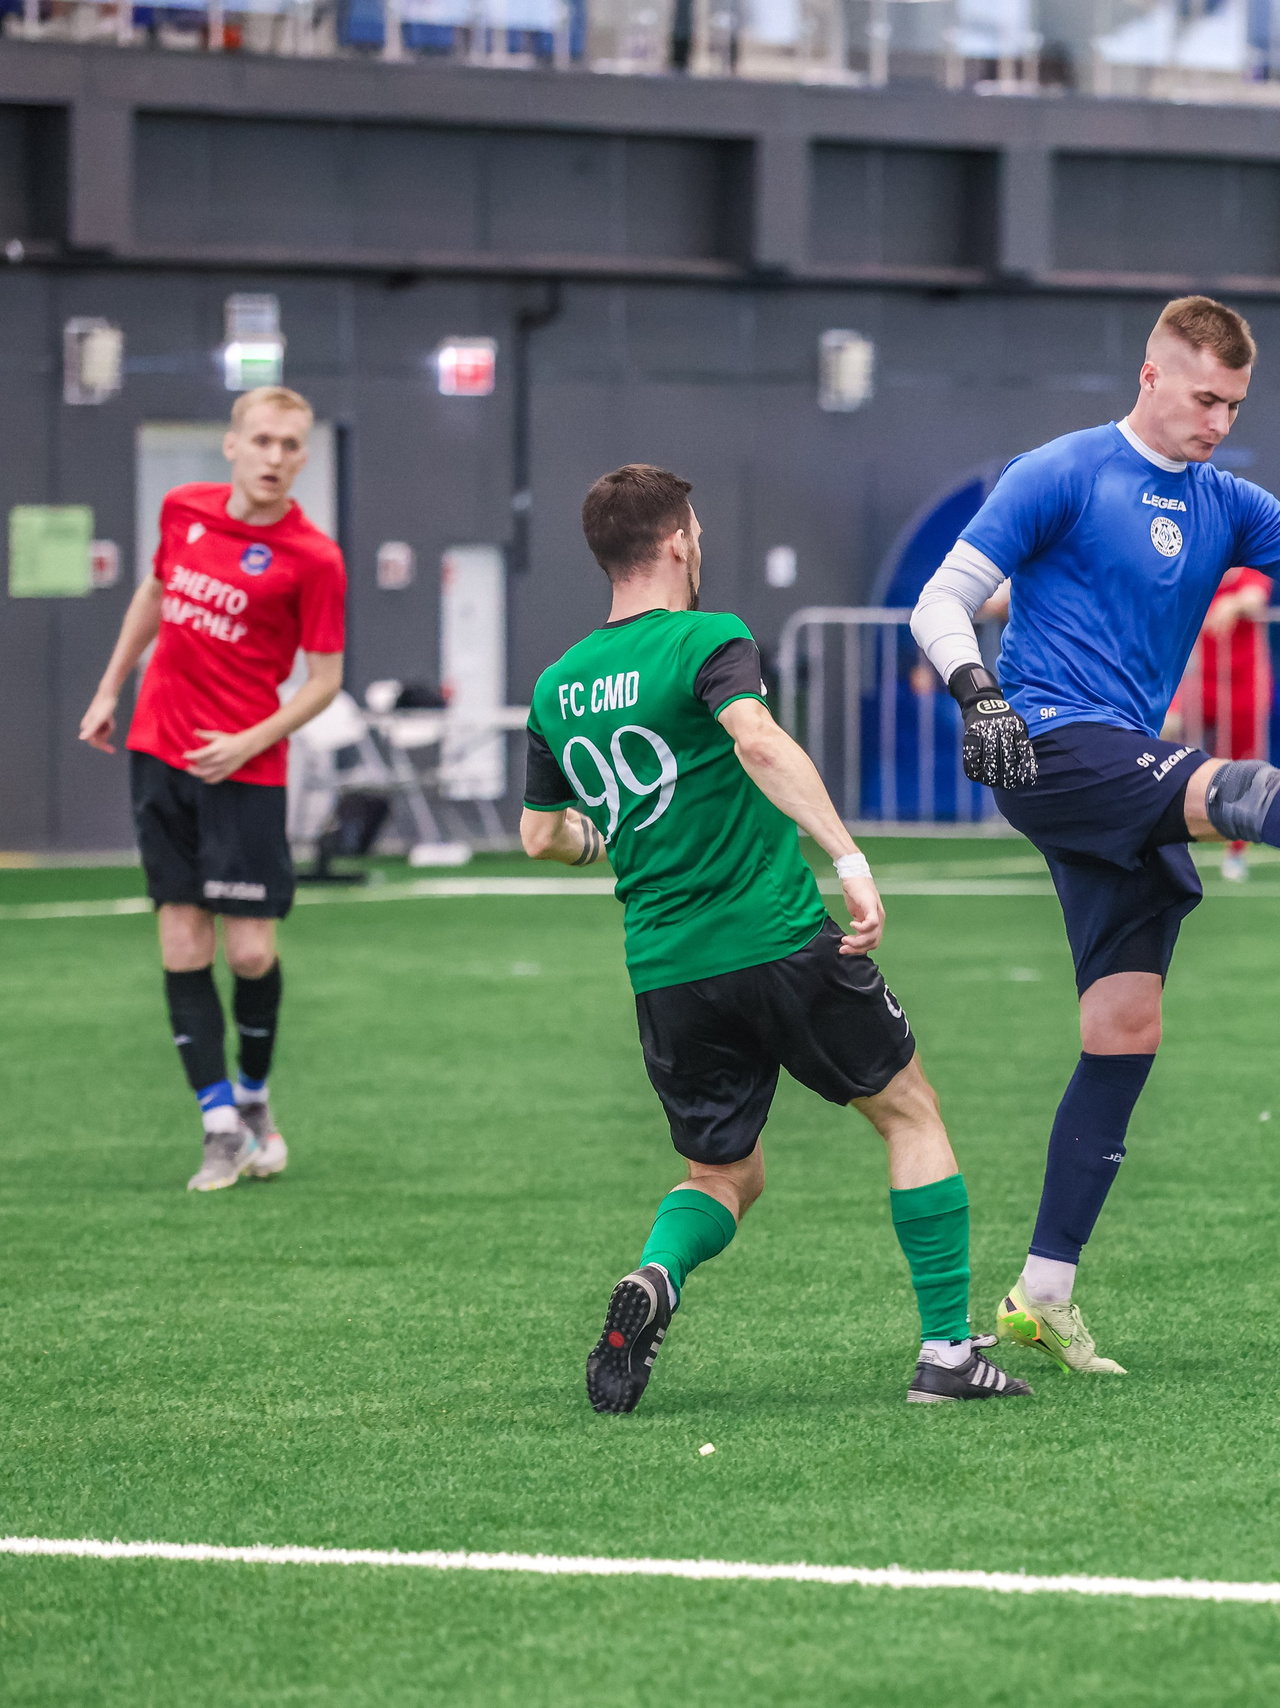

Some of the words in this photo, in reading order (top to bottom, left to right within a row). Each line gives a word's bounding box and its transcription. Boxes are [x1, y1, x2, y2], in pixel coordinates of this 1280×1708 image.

[1142, 492, 1187, 512] LEGEA
[558, 681, 585, 720] FC
[590, 670, 640, 713] CMD
[1040, 707, 1057, 720] 96
[1136, 752, 1156, 768] 96
[562, 724, 678, 845] 99
